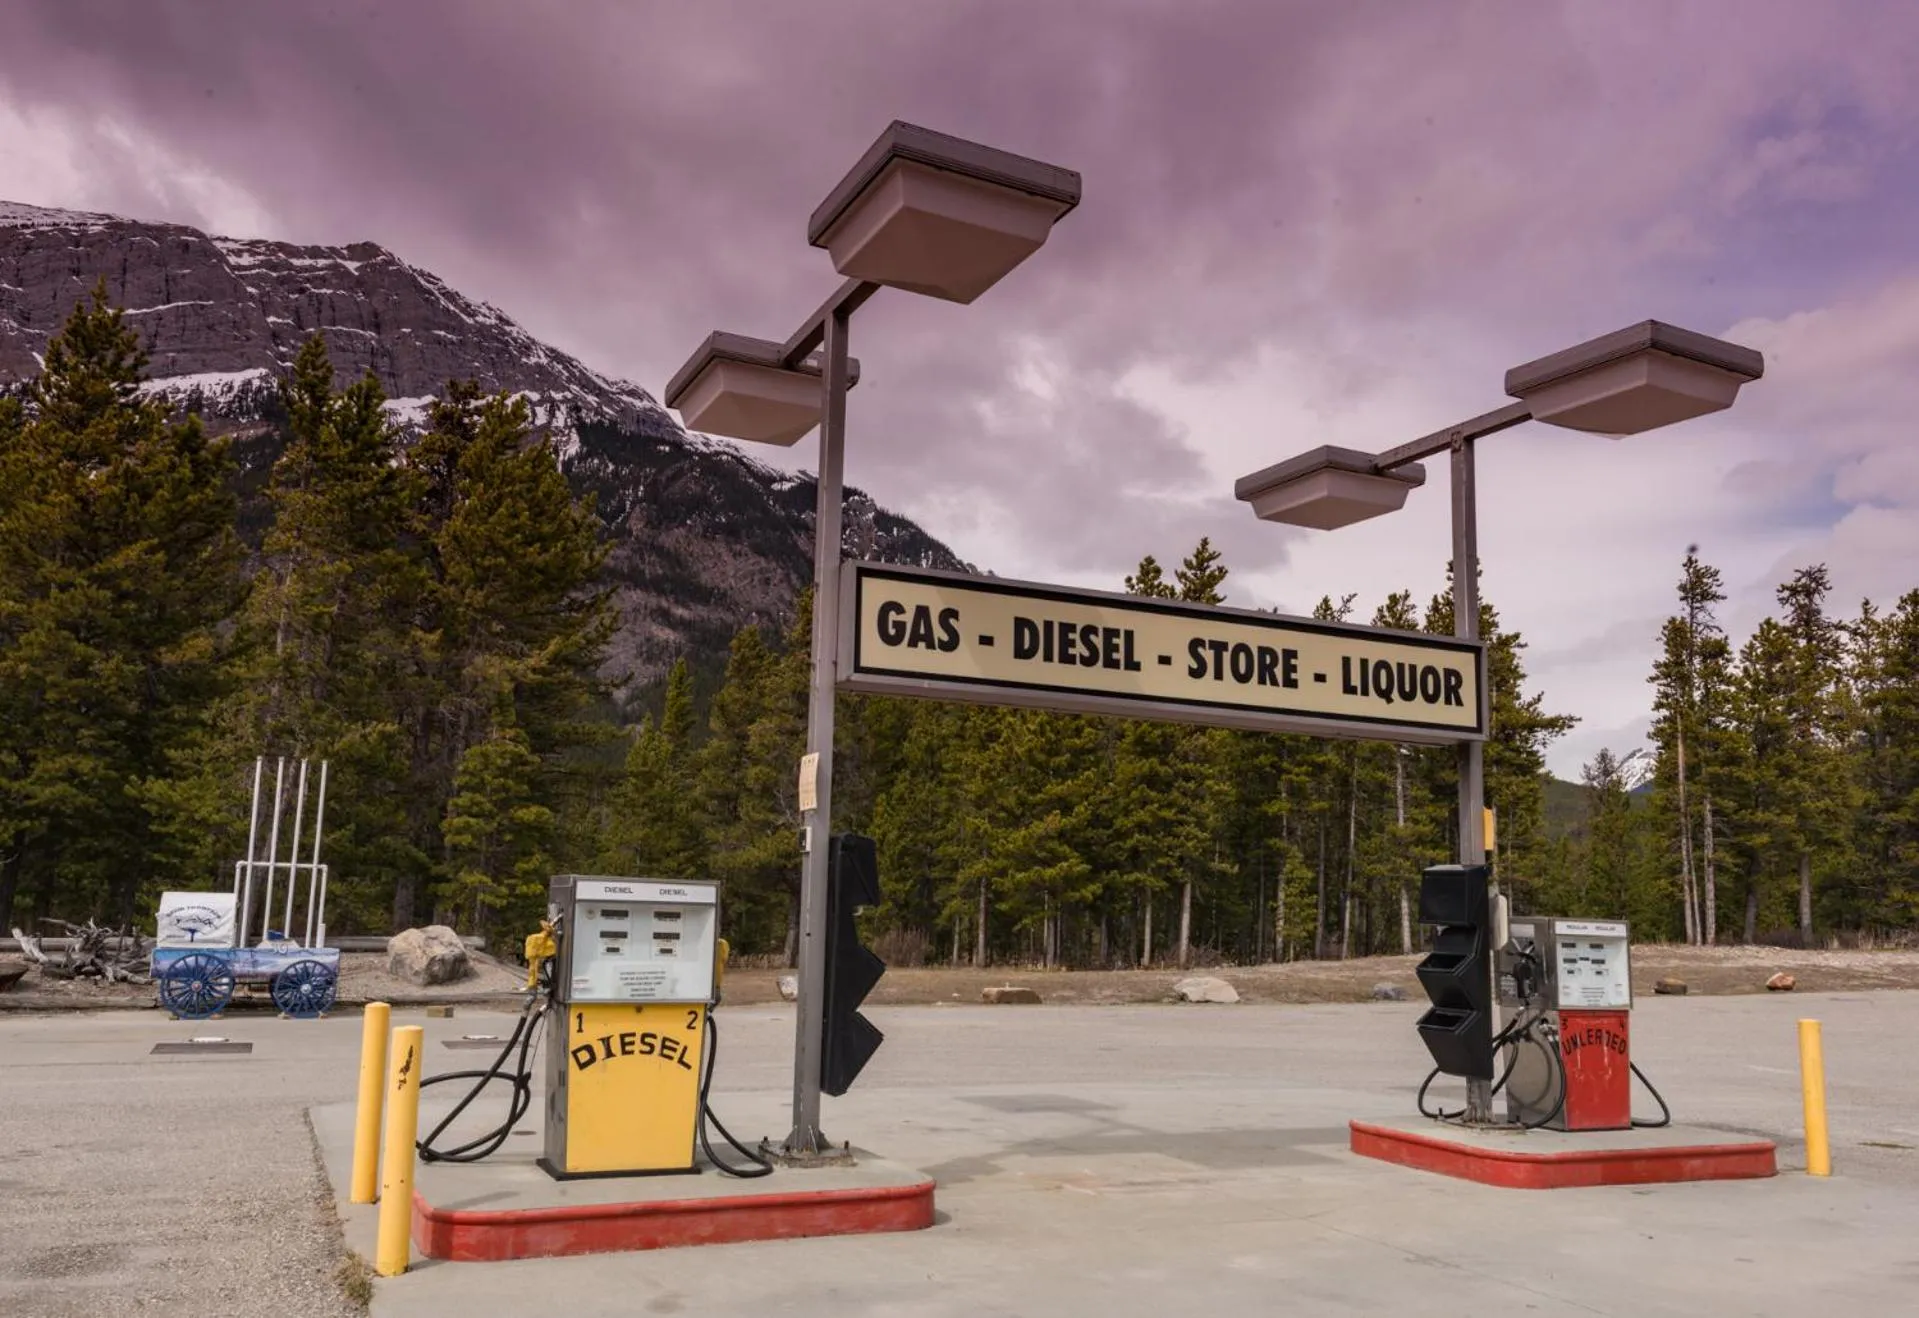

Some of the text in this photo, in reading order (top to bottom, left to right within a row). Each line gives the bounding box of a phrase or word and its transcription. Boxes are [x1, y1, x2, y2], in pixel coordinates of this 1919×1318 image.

[876, 600, 961, 653] GAS
[1012, 615, 1142, 673] DIESEL
[1187, 637, 1299, 690] STORE
[1341, 655, 1465, 708] LIQUOR
[604, 886, 634, 895] DIESEL
[659, 888, 688, 897] DIESEL
[576, 1012, 584, 1034] 1
[686, 1010, 699, 1031] 2
[571, 1032, 693, 1071] DIESEL
